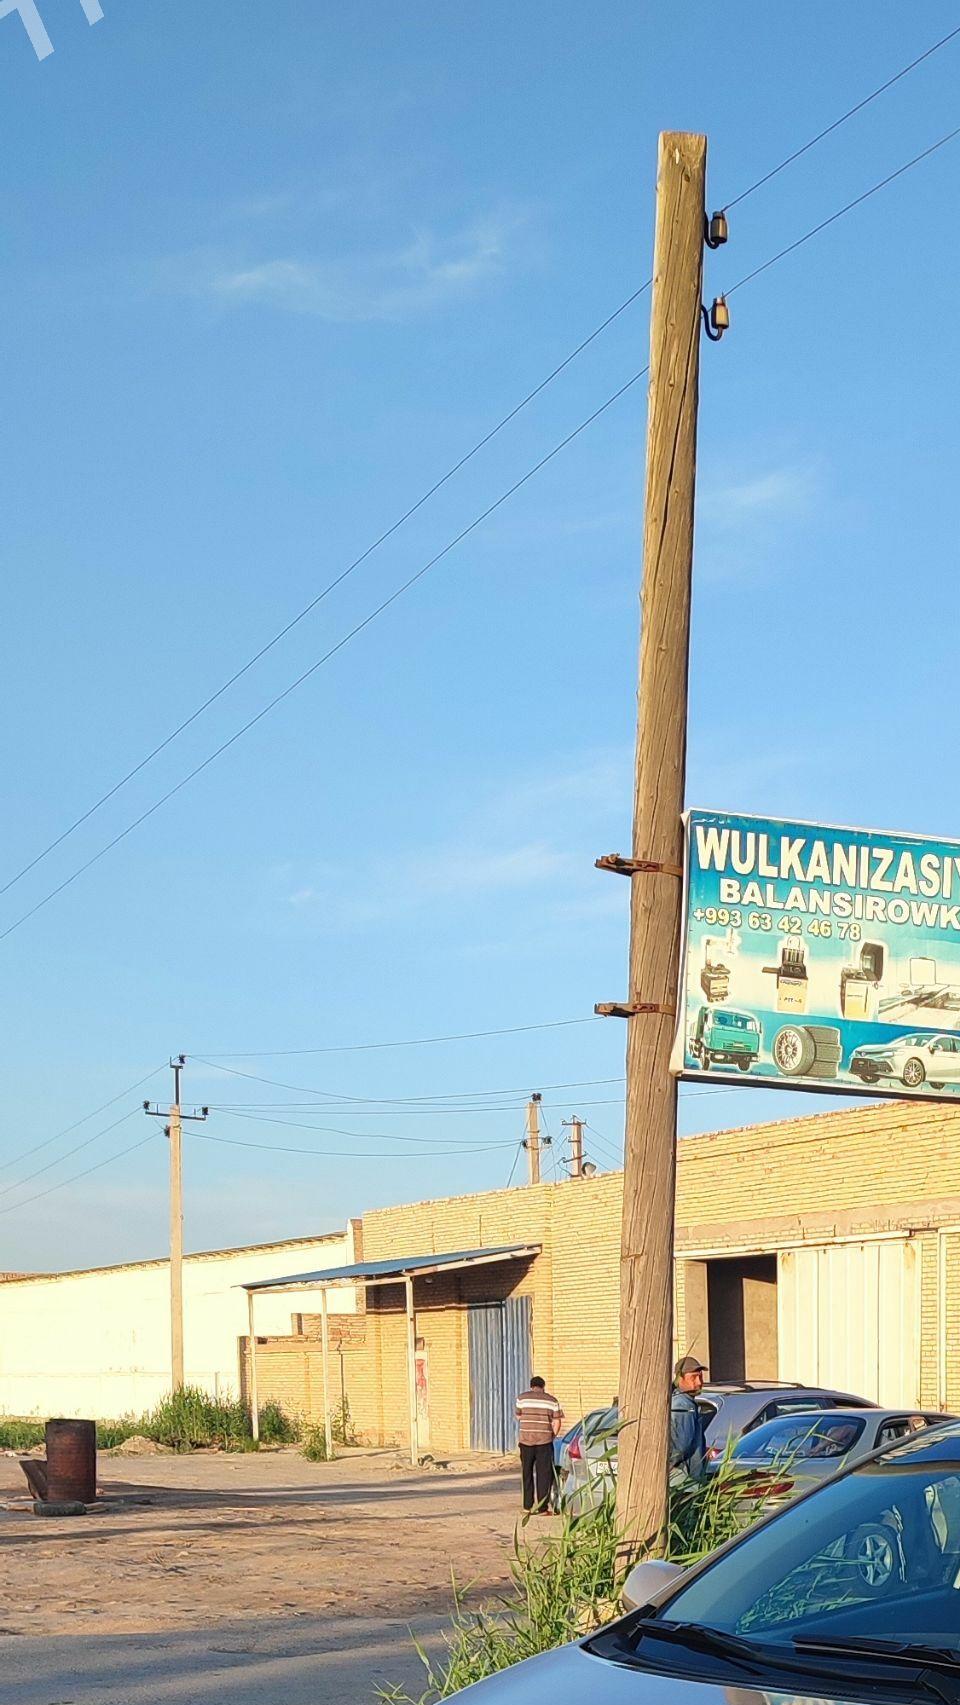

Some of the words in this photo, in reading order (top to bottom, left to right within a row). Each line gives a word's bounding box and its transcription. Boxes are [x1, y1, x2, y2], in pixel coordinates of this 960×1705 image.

[693, 907, 742, 927] +993
[749, 912, 772, 930] 63
[778, 915, 802, 935] 42
[807, 918, 832, 937] 46
[837, 922, 861, 941] 78
